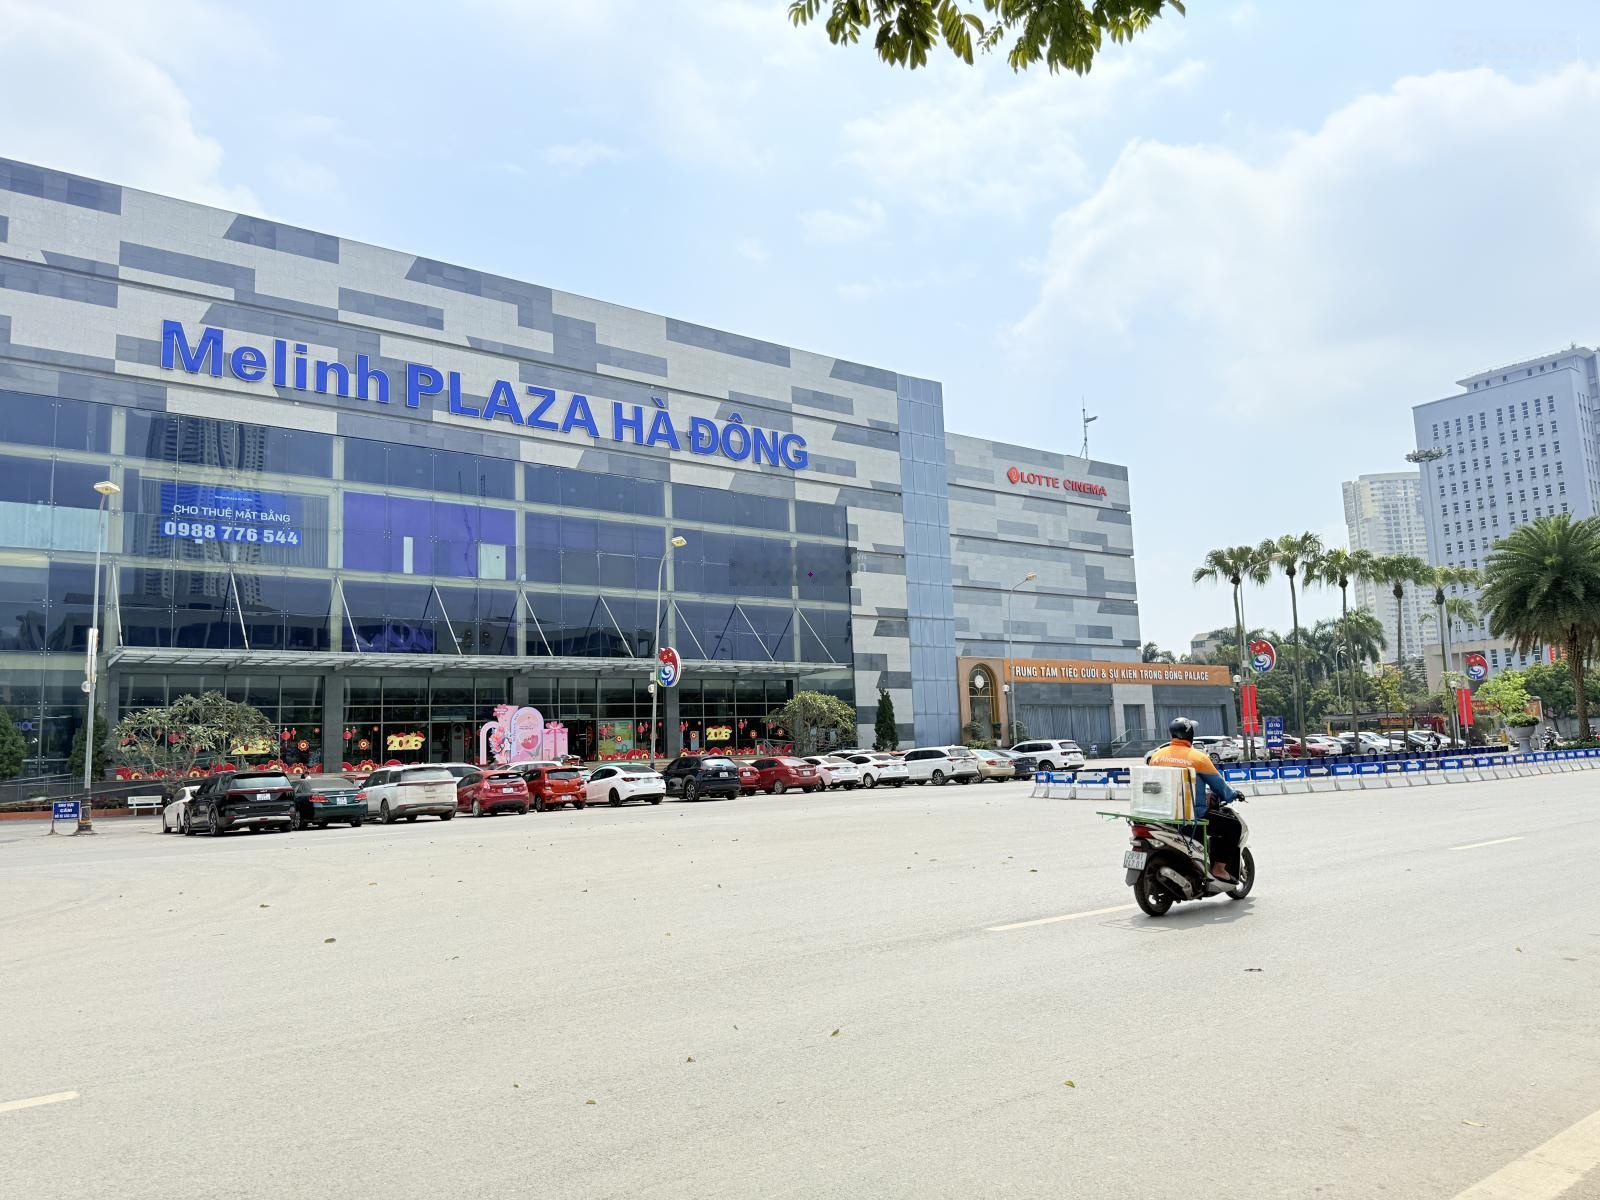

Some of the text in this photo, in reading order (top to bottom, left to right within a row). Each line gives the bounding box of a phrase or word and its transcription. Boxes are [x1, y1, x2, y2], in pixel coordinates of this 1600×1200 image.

[161, 319, 808, 471] Melinh PLAZA HÀ ĐÔNG
[1020, 471, 1107, 496] LOTTE CINEMA
[173, 504, 291, 523] CHO THUÊ MẶT BẰNG
[164, 521, 299, 545] 0988 776 544
[1101, 668, 1107, 678] &
[1184, 671, 1209, 681] PALACE
[387, 733, 426, 751] 2026
[706, 728, 732, 741] 2026
